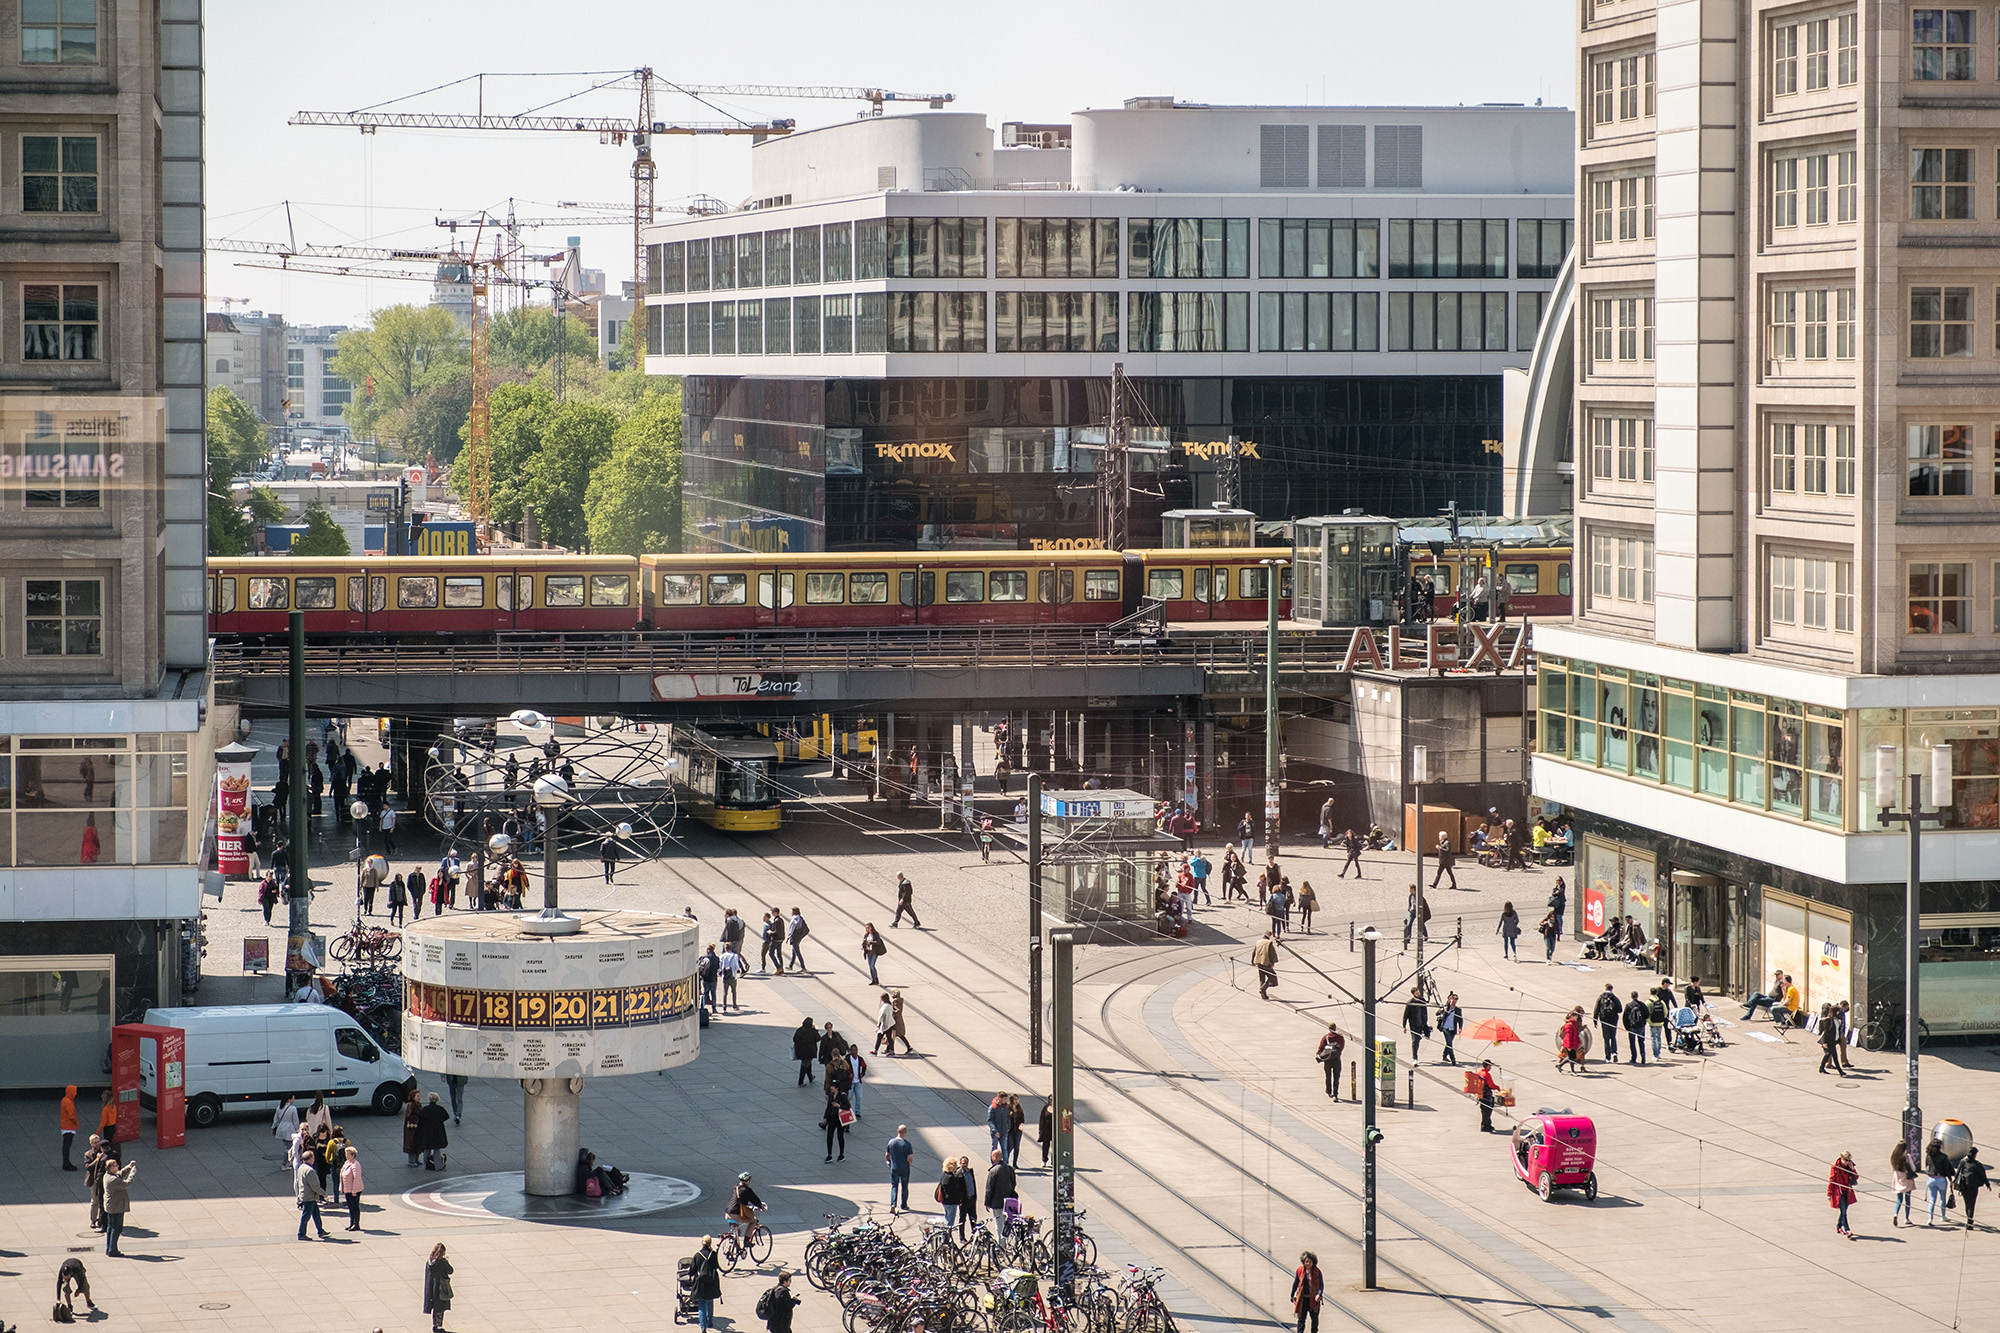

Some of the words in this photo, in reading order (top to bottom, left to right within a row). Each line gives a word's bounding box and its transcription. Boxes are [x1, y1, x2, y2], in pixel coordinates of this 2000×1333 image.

[1824, 936, 1838, 959] dm
[453, 994, 476, 1016] 17
[483, 996, 509, 1019] 18
[518, 997, 546, 1020] 19
[552, 996, 586, 1020] 20
[593, 994, 618, 1018] 21
[624, 991, 651, 1016] 22
[653, 987, 672, 1012] 23
